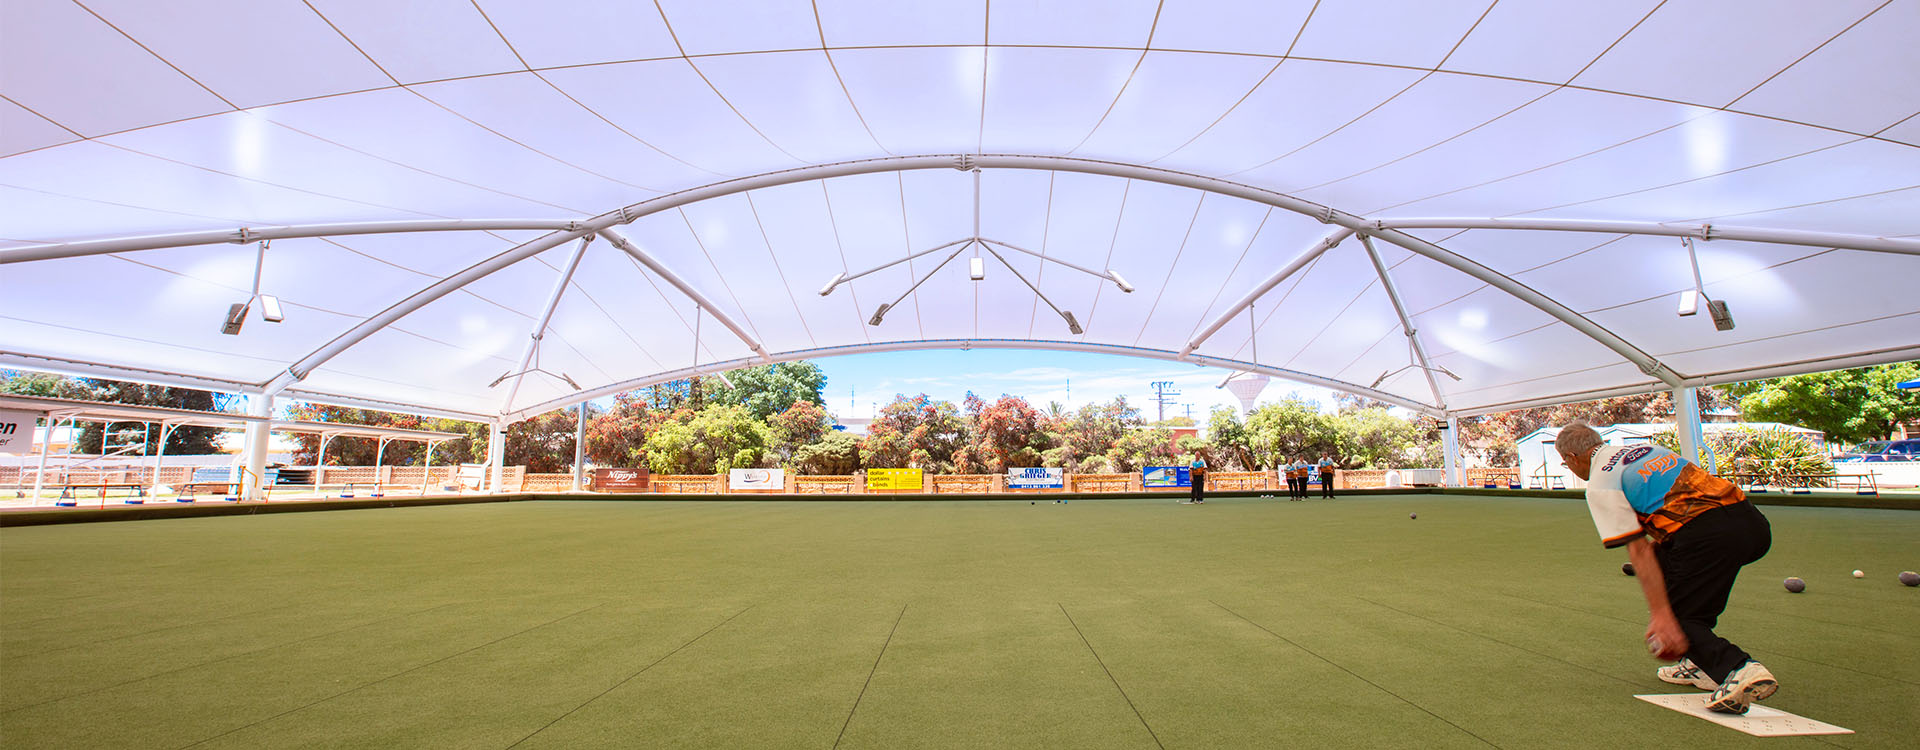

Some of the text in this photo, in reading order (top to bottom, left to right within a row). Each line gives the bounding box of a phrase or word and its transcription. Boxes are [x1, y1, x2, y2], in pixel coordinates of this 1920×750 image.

[1601, 446, 1630, 472] Sutton
[1627, 448, 1648, 461] Ford
[607, 470, 638, 482] Nippy's
